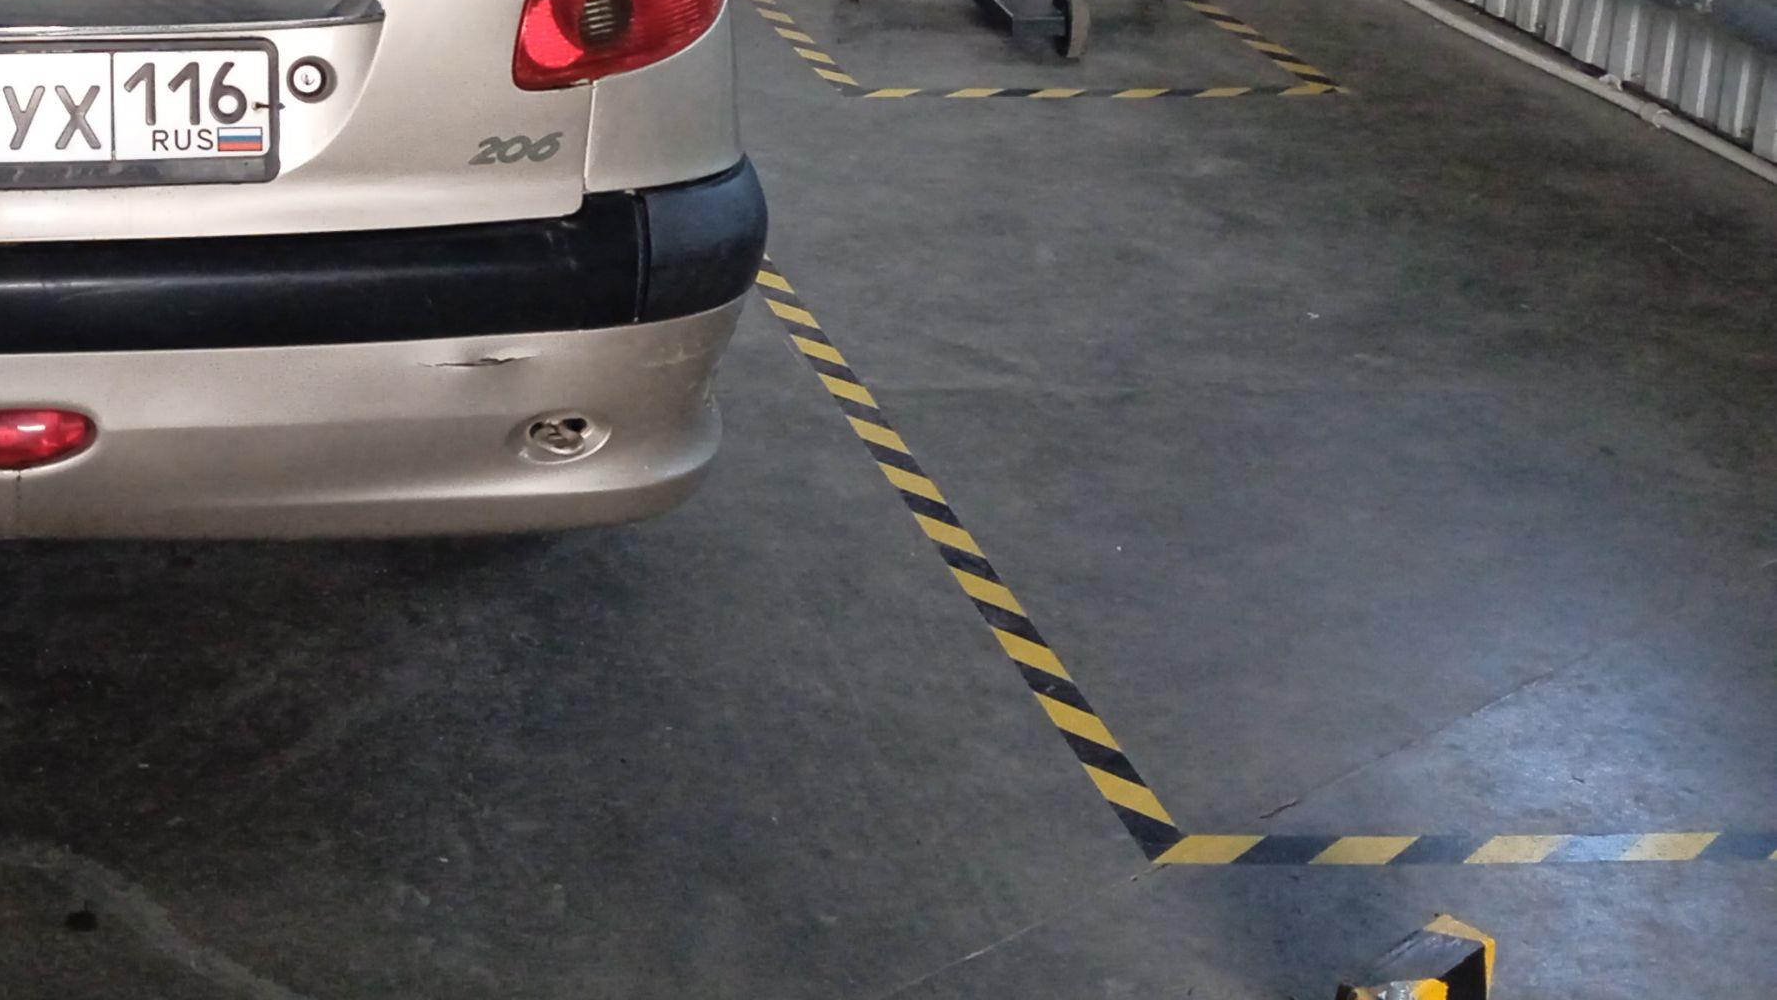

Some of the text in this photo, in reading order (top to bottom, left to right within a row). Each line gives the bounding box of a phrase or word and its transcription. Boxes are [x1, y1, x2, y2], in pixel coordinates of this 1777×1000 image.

[123, 61, 248, 125] 116
[151, 128, 214, 152] RUS
[468, 131, 564, 165] 206
